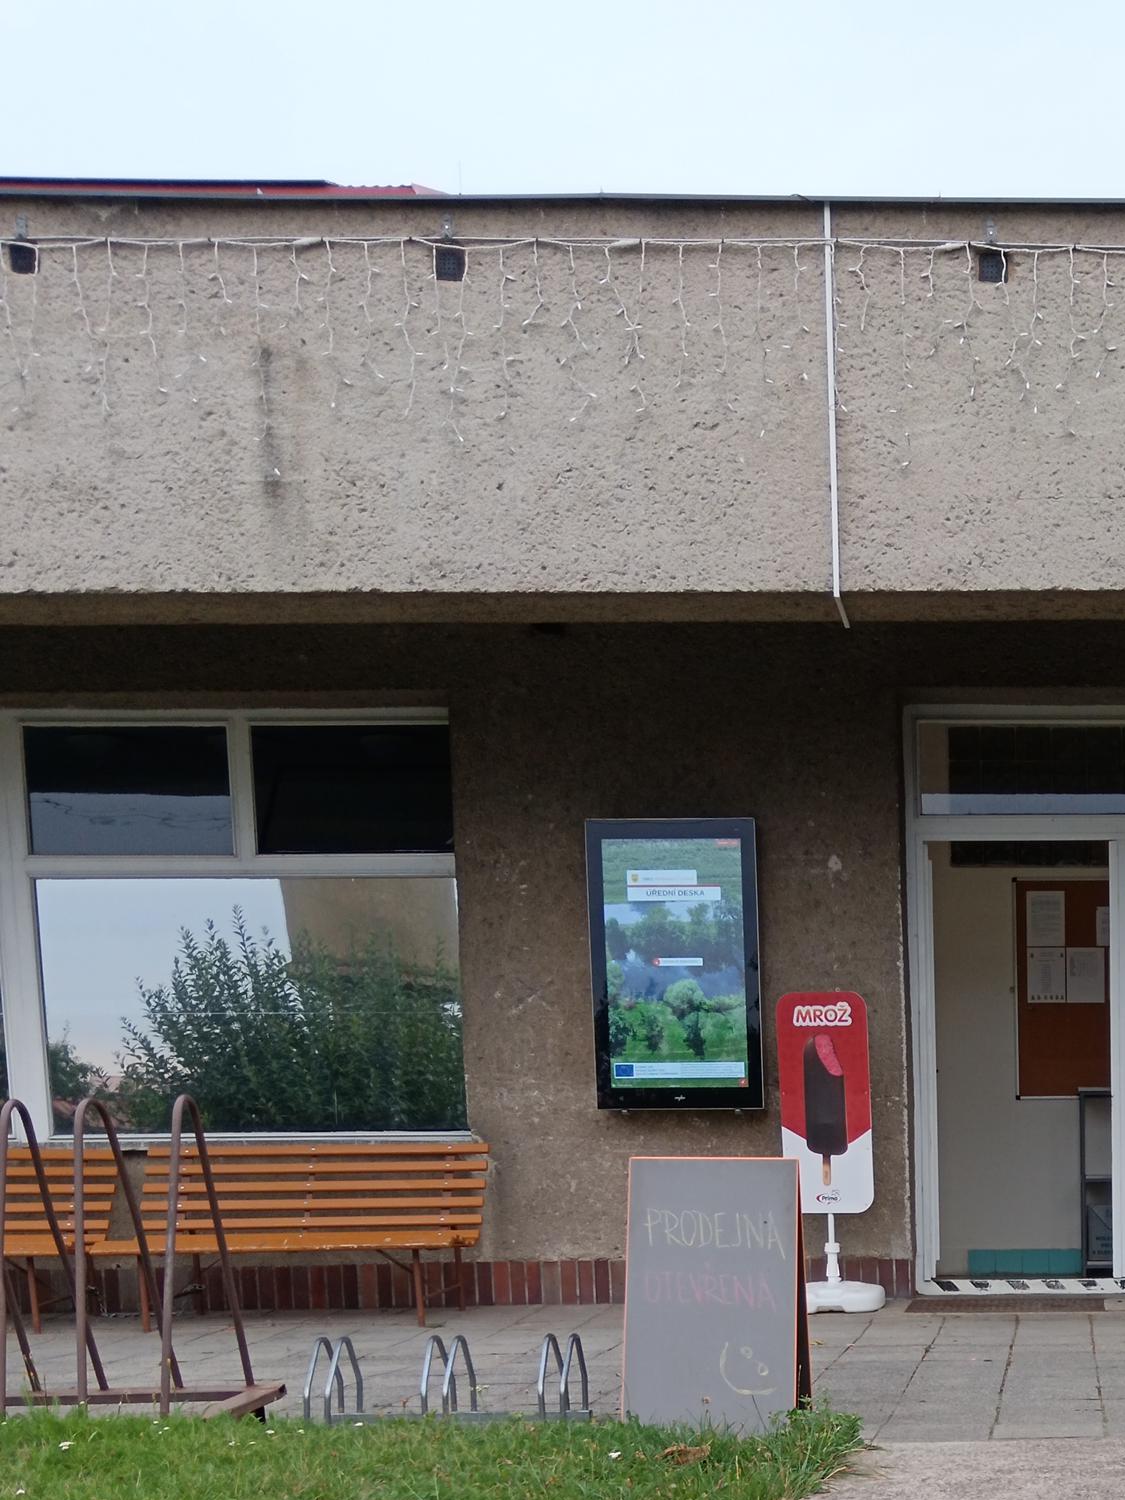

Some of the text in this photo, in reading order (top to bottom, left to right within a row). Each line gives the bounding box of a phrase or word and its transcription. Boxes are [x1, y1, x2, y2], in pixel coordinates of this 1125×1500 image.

[646, 887, 705, 897] ÚŘEDNÍ DESKA
[795, 1005, 850, 1023] MROŽ
[644, 1207, 786, 1260] PRODEJNA
